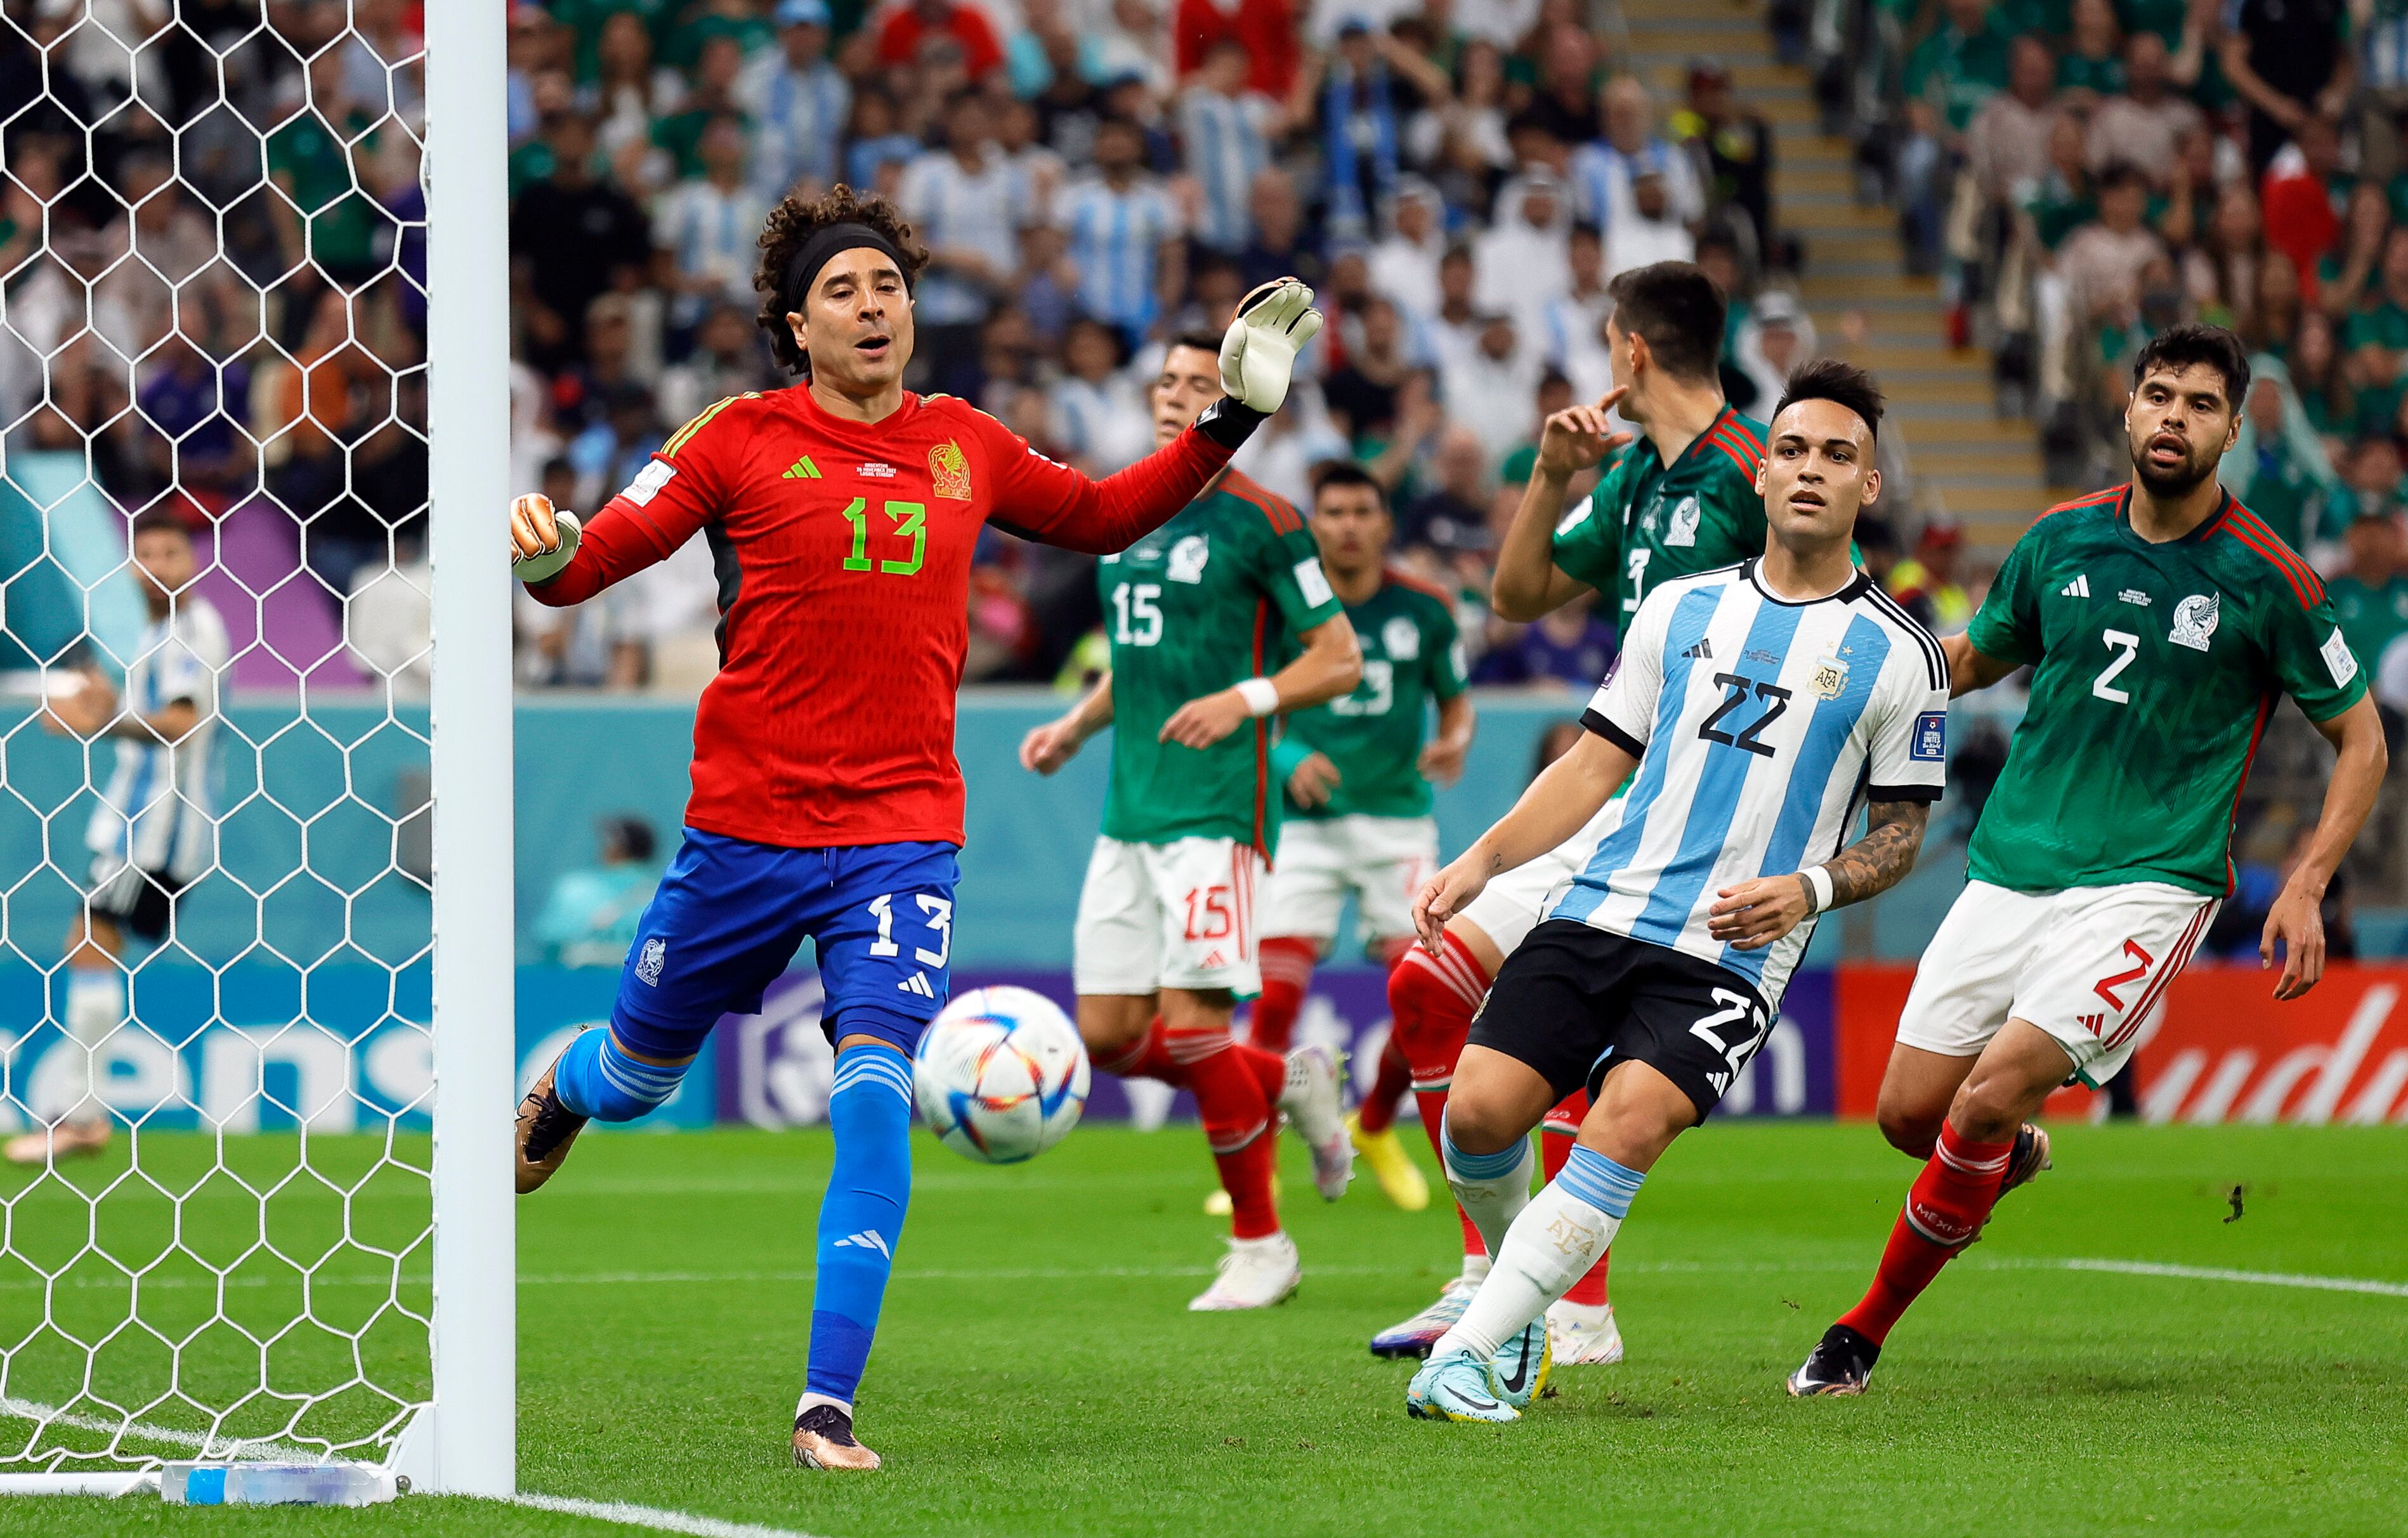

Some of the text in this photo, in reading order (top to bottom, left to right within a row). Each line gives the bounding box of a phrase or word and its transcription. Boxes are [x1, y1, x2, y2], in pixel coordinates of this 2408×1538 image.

[842, 497, 927, 575] 13
[1113, 582, 1163, 646] 15
[1623, 548, 1651, 613] 3
[1815, 667, 1837, 688] AFA
[2093, 629, 2140, 705] 2
[1698, 673, 1792, 758] 22
[868, 894, 952, 969] 13
[1184, 886, 1232, 941] 15
[2094, 939, 2154, 1013] 2
[1689, 987, 1767, 1080] 22
[1545, 1209, 1594, 1256] AFA
